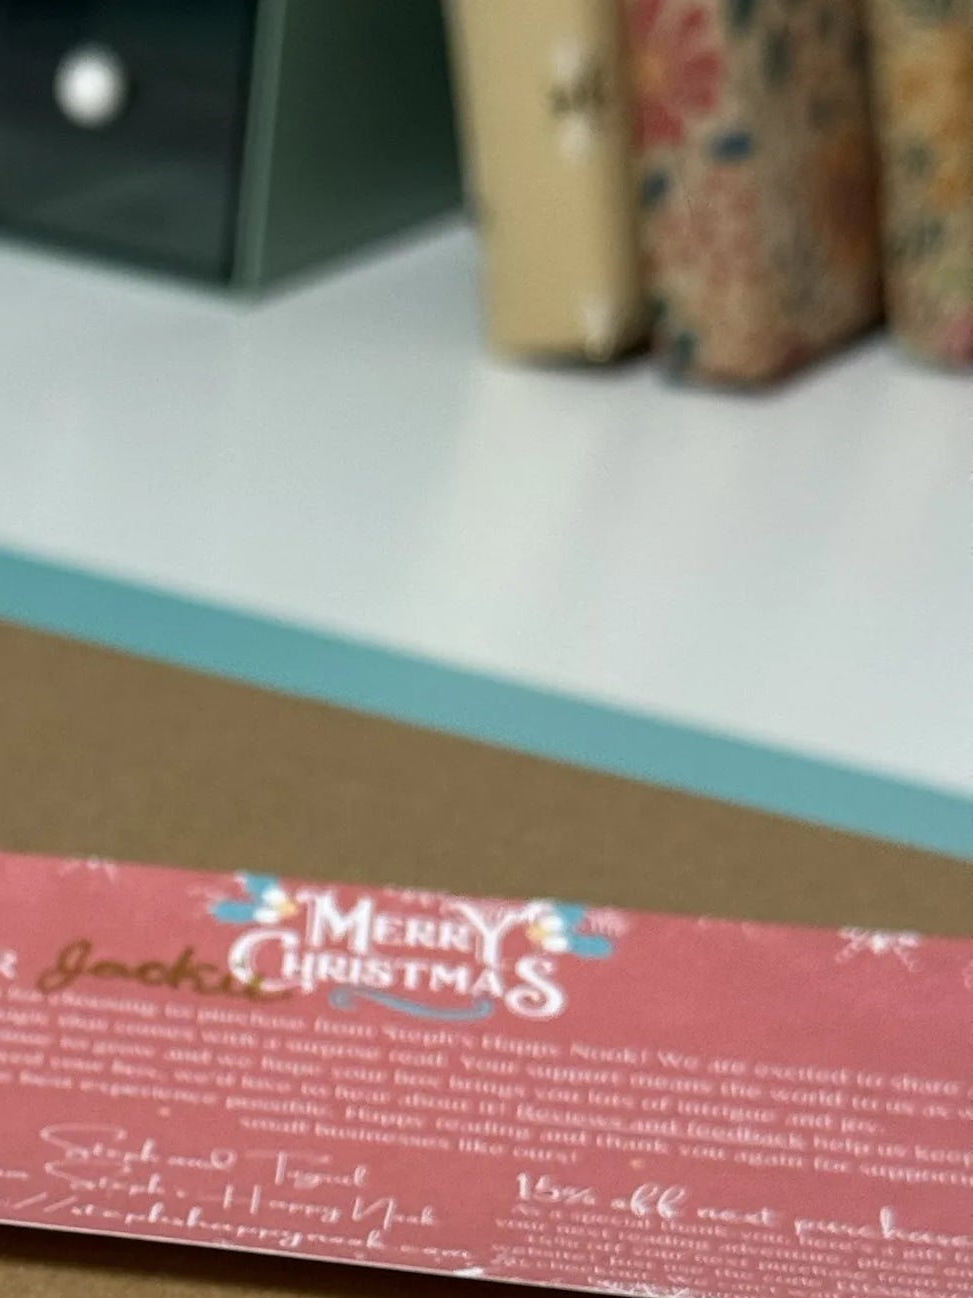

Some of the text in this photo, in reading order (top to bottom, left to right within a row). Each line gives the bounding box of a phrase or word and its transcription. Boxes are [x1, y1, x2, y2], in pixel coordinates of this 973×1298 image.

[297, 886, 552, 965] MERRY
[229, 928, 564, 1018] CHRISTMAS
[610, 1184, 687, 1219] off
